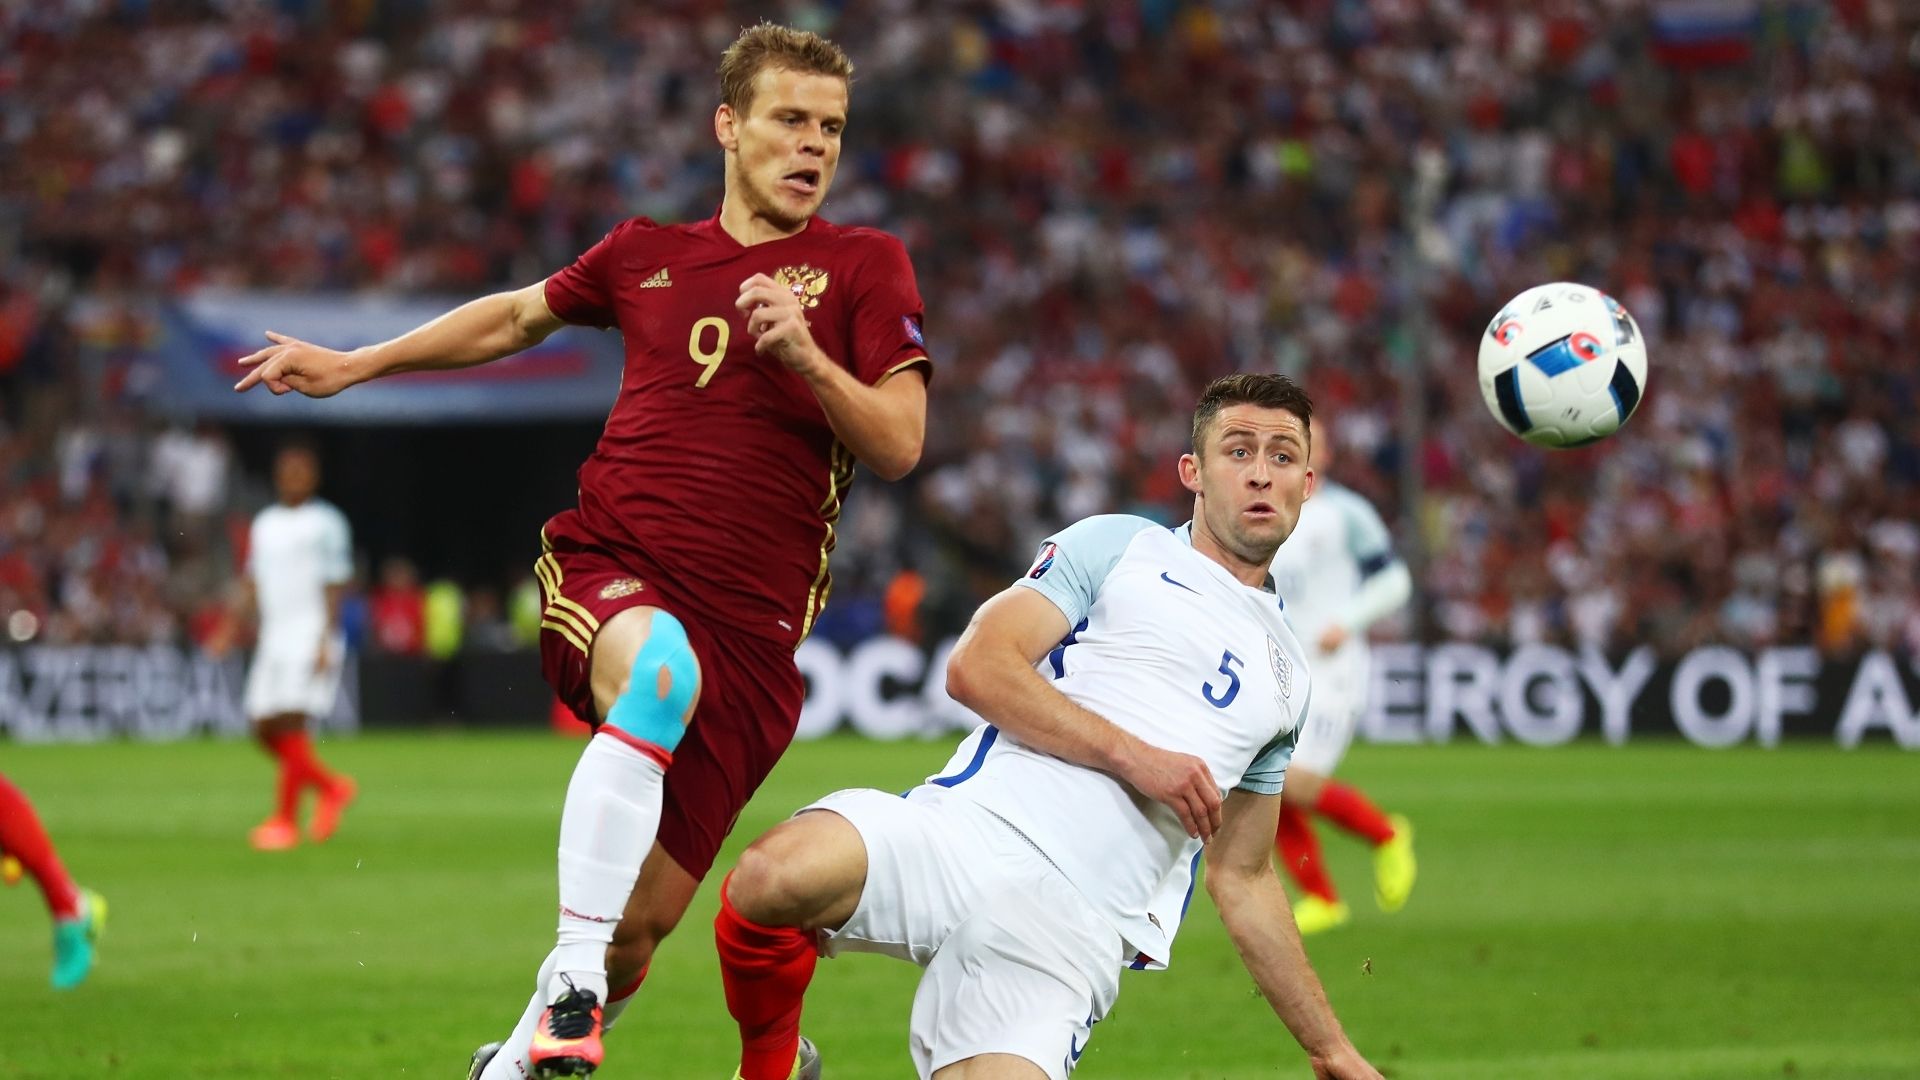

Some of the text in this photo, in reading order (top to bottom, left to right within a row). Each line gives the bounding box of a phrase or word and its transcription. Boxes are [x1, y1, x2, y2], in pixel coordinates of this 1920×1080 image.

[640, 278, 672, 288] adidas
[688, 316, 730, 389] 9
[1201, 648, 1245, 709] 5
[1364, 641, 1920, 749] ERGY OF A
